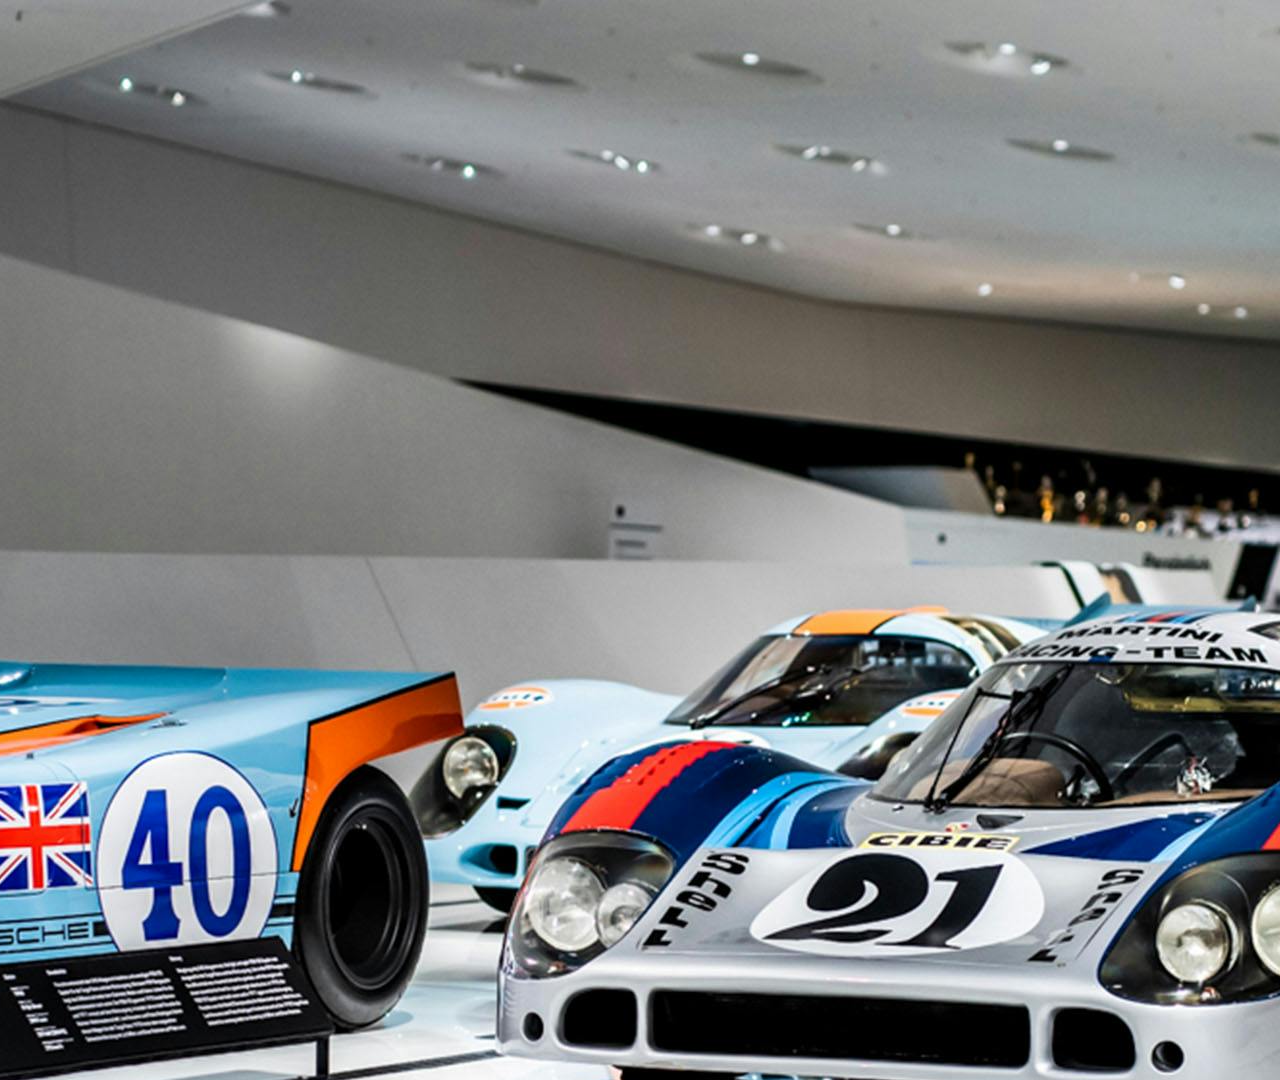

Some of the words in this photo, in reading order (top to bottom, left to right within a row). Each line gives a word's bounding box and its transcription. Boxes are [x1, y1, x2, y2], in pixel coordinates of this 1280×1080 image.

[1008, 644, 1269, 664] ACING-TEAM
[1056, 625, 1224, 643] MARTINI
[122, 784, 252, 942] 40
[763, 852, 1004, 949] 21
